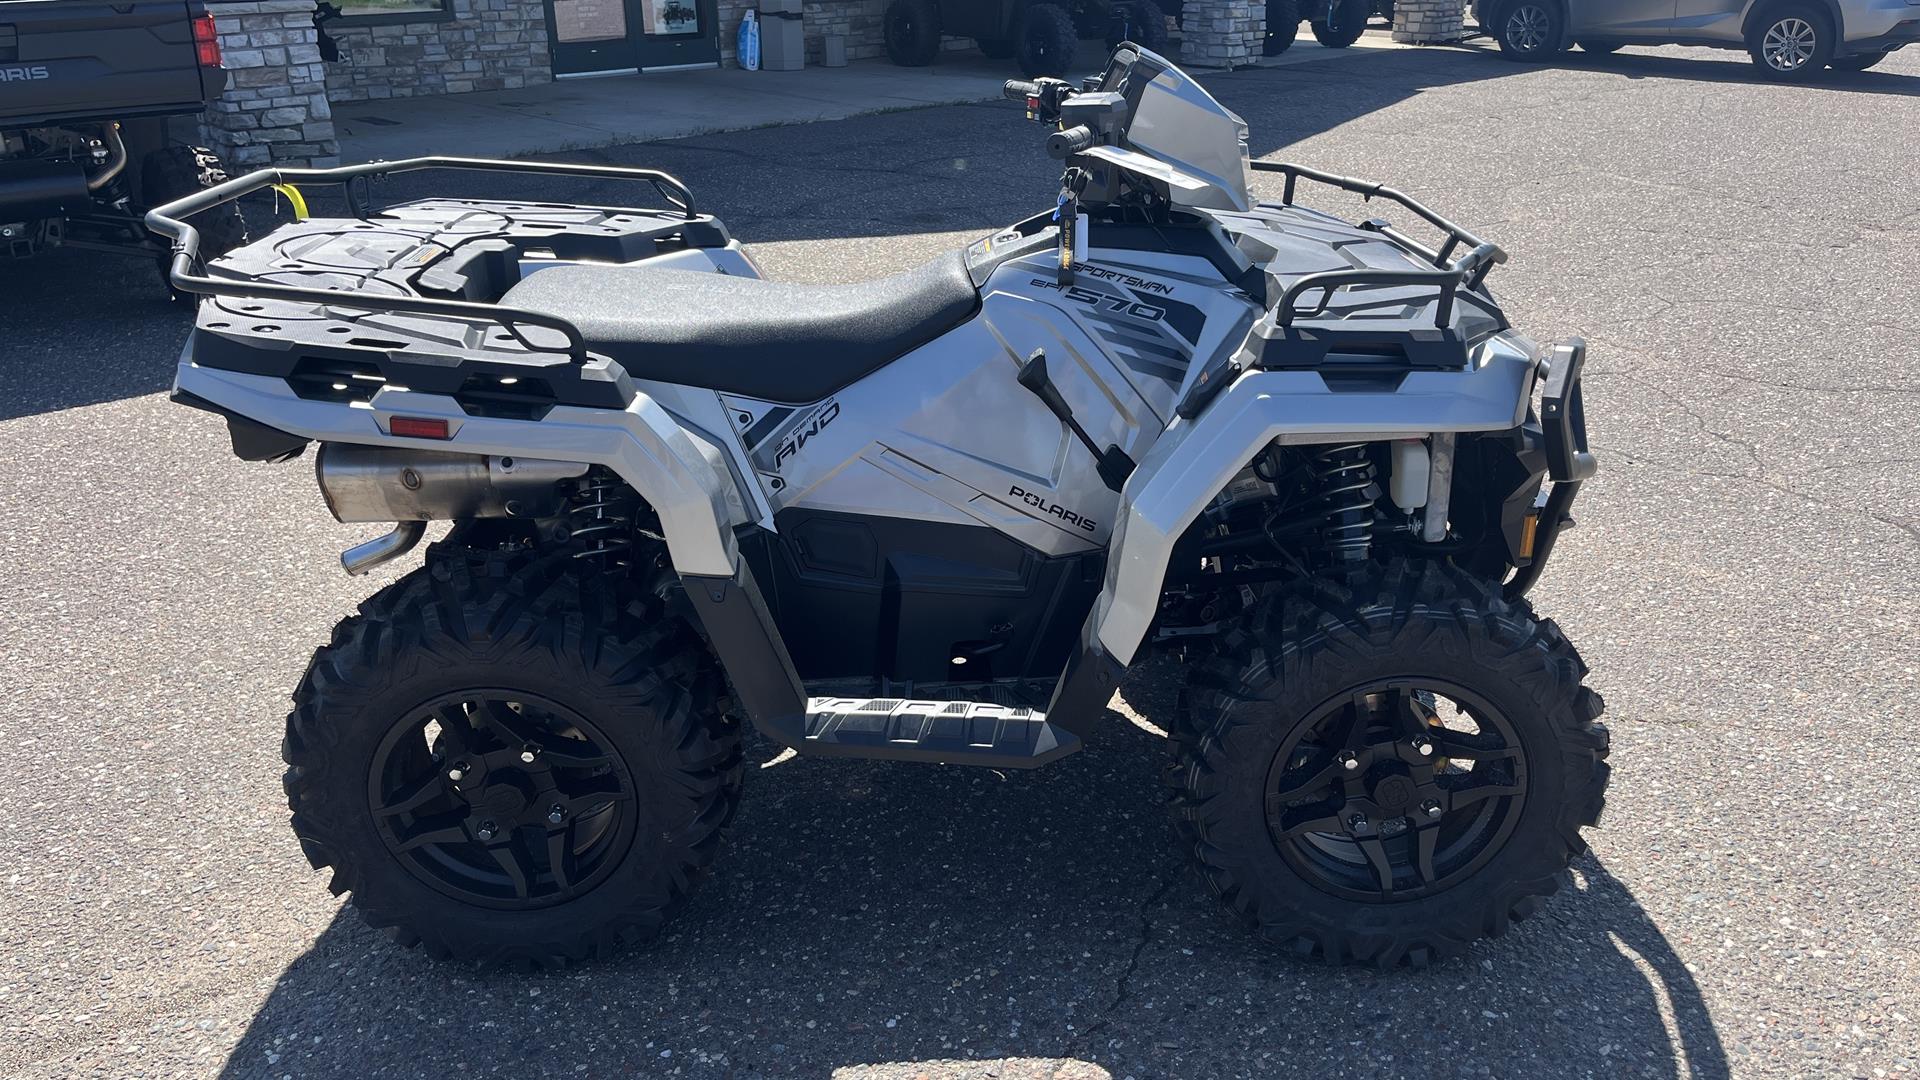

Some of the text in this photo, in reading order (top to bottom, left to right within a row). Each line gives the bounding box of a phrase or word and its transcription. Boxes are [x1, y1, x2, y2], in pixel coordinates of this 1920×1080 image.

[1072, 262, 1175, 295] SPORTSMAN
[1065, 286, 1166, 322] 570
[775, 402, 840, 469] AWD
[792, 396, 834, 436] DEMAND
[1009, 485, 1097, 532] POLARIS
